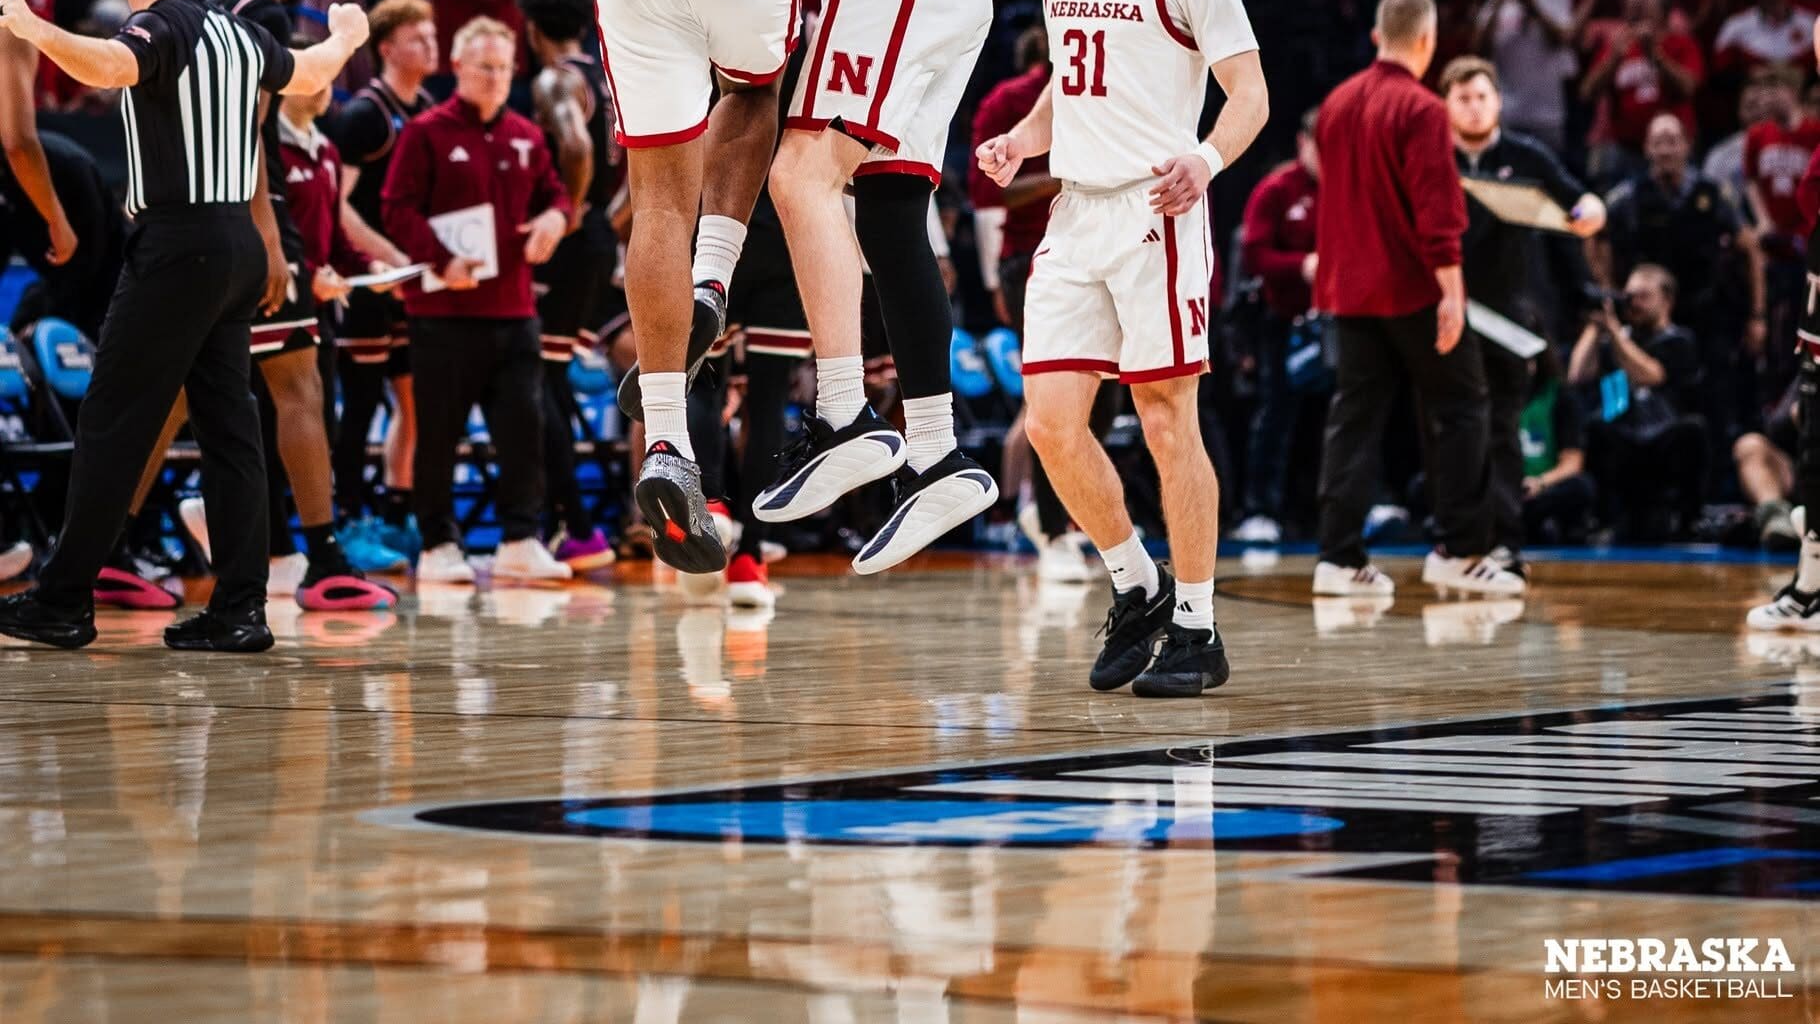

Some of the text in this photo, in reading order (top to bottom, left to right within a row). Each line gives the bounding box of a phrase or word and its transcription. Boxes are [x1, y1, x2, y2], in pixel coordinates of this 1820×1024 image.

[1050, 0, 1144, 22] NEBRASKA
[826, 50, 875, 97] N
[1062, 29, 1107, 97] 31
[1187, 296, 1207, 337] N
